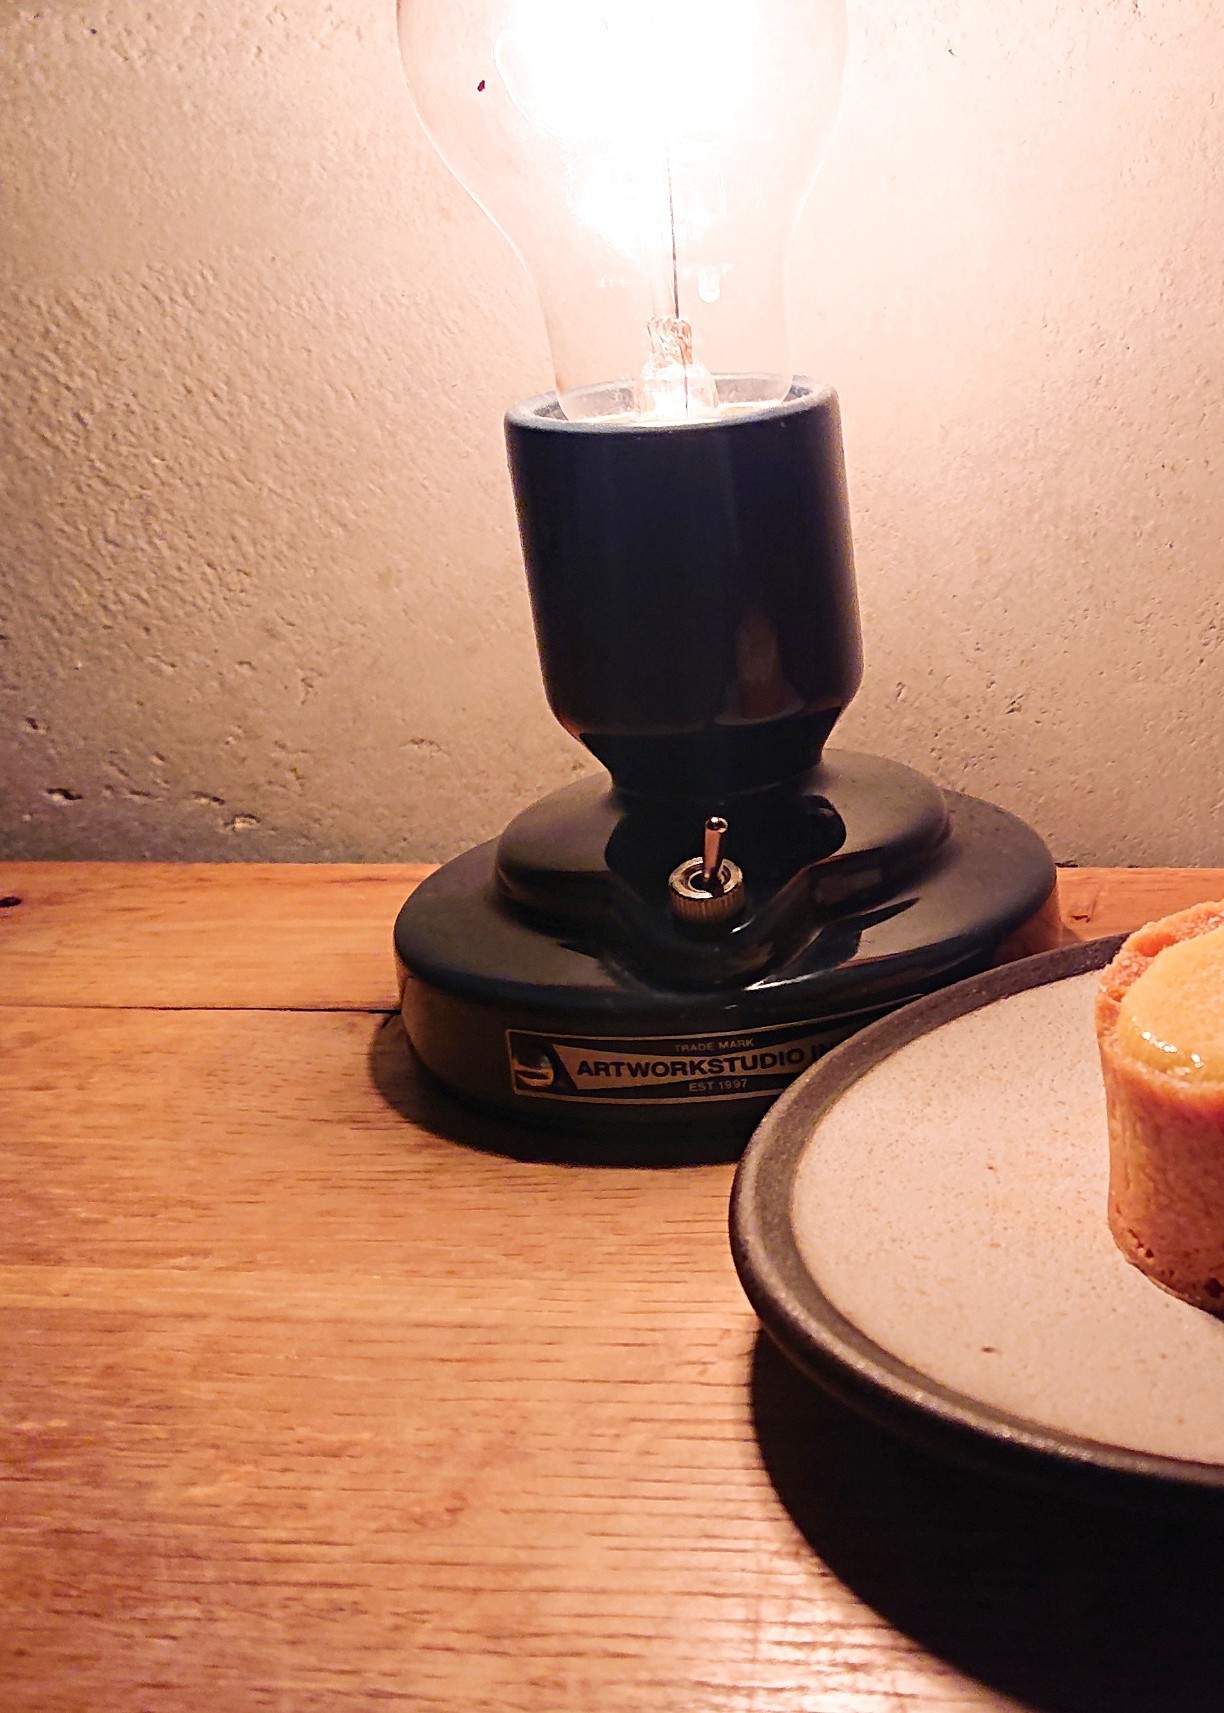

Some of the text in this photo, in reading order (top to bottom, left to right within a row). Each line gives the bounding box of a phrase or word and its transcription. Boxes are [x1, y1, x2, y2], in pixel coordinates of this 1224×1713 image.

[674, 1038, 754, 1053] TRADE MARK
[577, 1048, 804, 1077] ARTWORKSTUDIO
[688, 1078, 748, 1092] EST 1997
